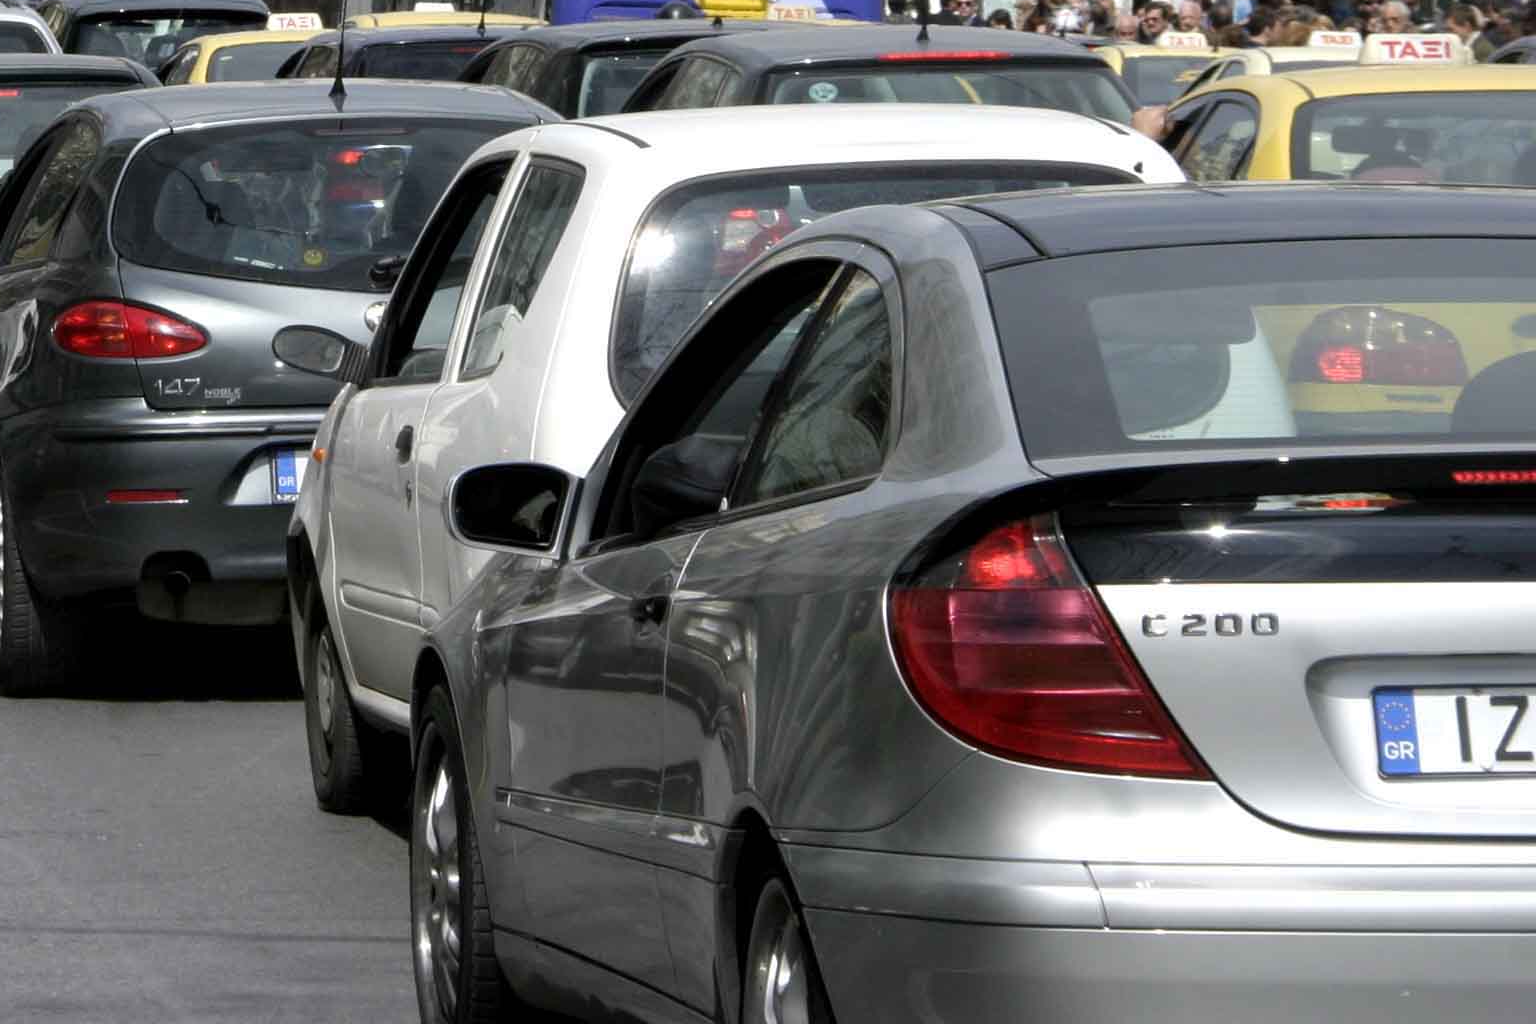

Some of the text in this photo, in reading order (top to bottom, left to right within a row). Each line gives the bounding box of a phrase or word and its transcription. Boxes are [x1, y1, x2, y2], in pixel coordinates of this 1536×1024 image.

[278, 16, 315, 27] ΤΑΞΙ
[1380, 40, 1452, 59] ΤΑΞΙ
[154, 377, 201, 396] 147
[1141, 612, 1281, 638] C 200
[1383, 740, 1416, 761] GR
